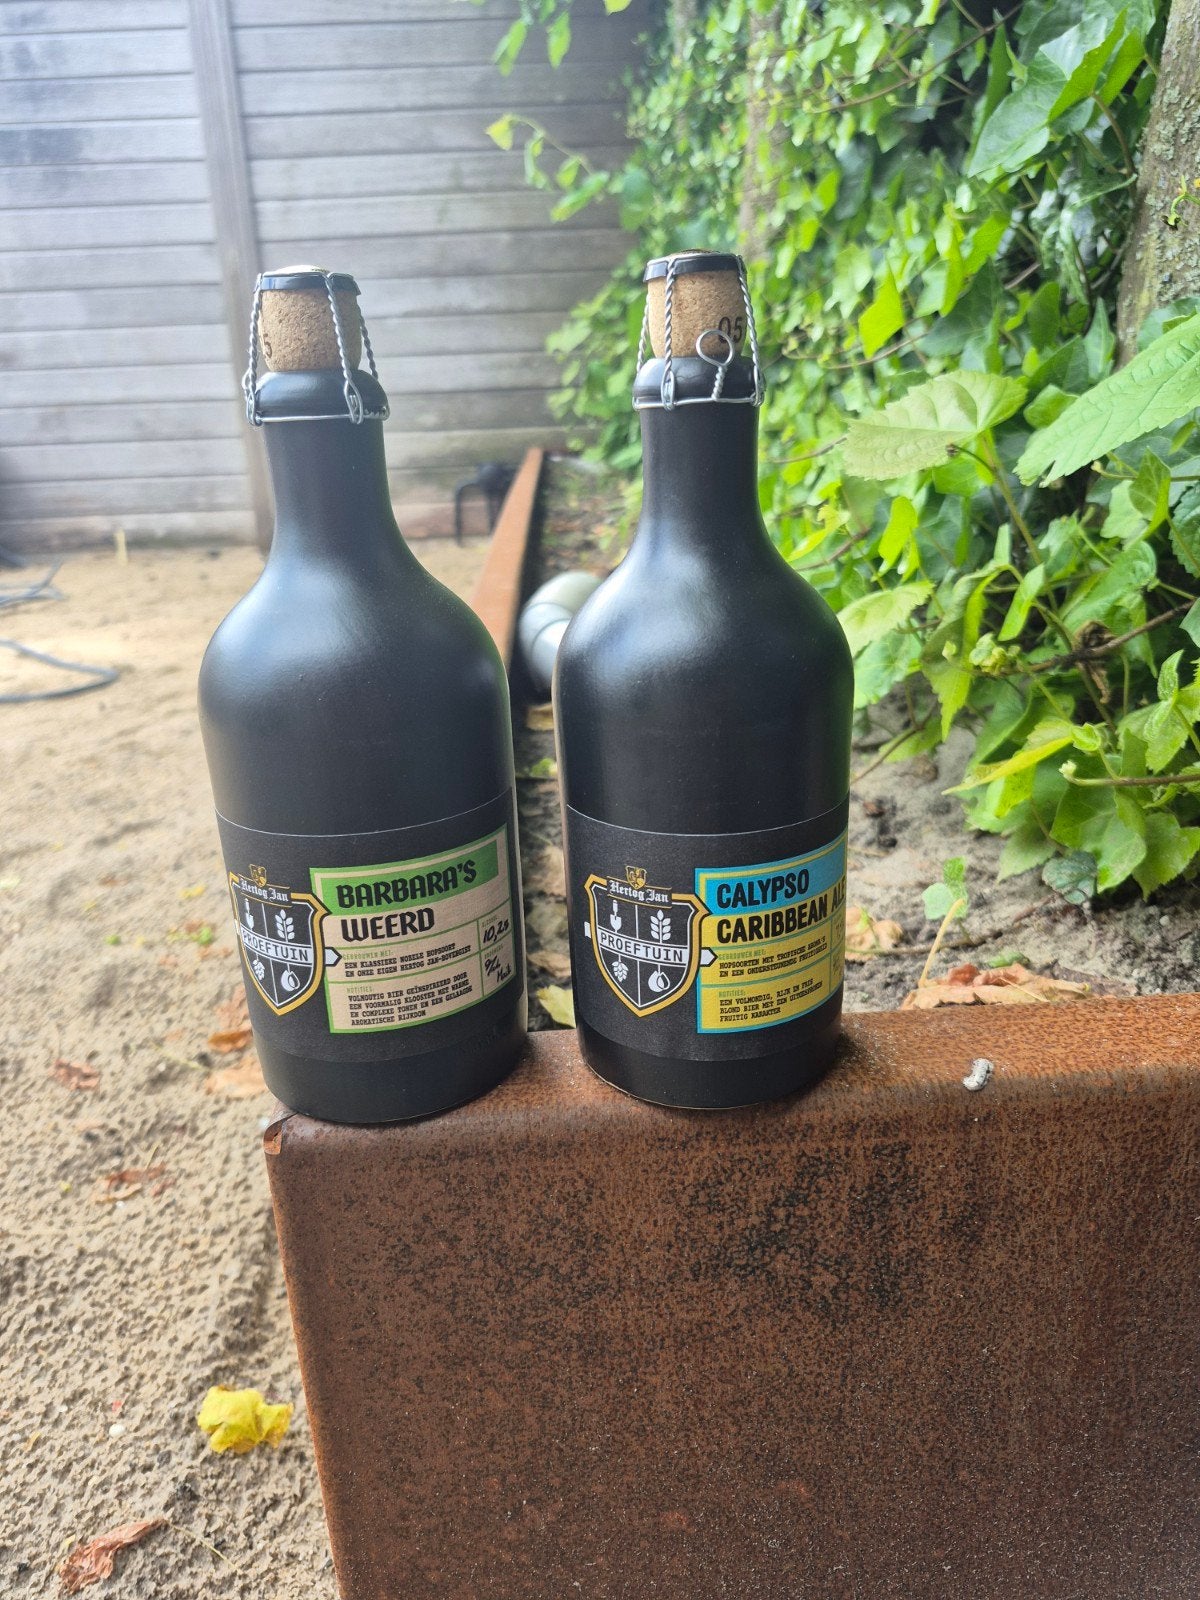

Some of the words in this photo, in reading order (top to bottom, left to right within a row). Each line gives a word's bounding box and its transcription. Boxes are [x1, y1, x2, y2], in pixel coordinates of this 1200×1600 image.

[240, 880, 268, 899] Hertog
[269, 888, 288, 902] Jan
[336, 860, 476, 908] BARBARA'S
[608, 880, 645, 901] Hertog
[646, 889, 669, 902] Jan
[717, 869, 809, 908] CALYPSO
[341, 908, 434, 942] WEERD
[717, 894, 827, 943] CARIBBEAN
[243, 930, 308, 961] PROEFTUIN
[361, 958, 397, 968] KLASSIEKE
[400, 953, 424, 962] NOBELE
[426, 943, 455, 957] HOPSOORT
[601, 933, 682, 962] PROEFTUIN
[358, 968, 374, 976] ONZE
[377, 966, 397, 974] EIGEN
[400, 961, 424, 971] HERTOG
[720, 958, 759, 969] HOPSOORTEN
[762, 956, 774, 964] MET
[777, 946, 806, 960] TROPISCHE
[732, 968, 744, 976] EEN
[348, 994, 384, 1002] VOLMOUTIG
[388, 990, 403, 999] BIER
[453, 972, 467, 982] DOOR
[735, 994, 772, 1004] VOLMONDIG,
[777, 988, 790, 998] RIJK
[802, 979, 813, 988] FRIS
[362, 1008, 394, 1017] COMPLEXE
[398, 1004, 417, 1012] TONEN
[432, 997, 443, 1005] EEN
[365, 999, 401, 1009] VOORMALIG
[404, 992, 435, 1003] KLOOSTER
[744, 1003, 759, 1012] BIER
[762, 1000, 774, 1008] MET
[777, 997, 787, 1005] EEN
[352, 1016, 395, 1026] AROMATISCHE
[398, 1010, 426, 1021] RIJKDOM
[720, 1014, 748, 1022] FRUITIG
[751, 1007, 781, 1019] KARAKTER
